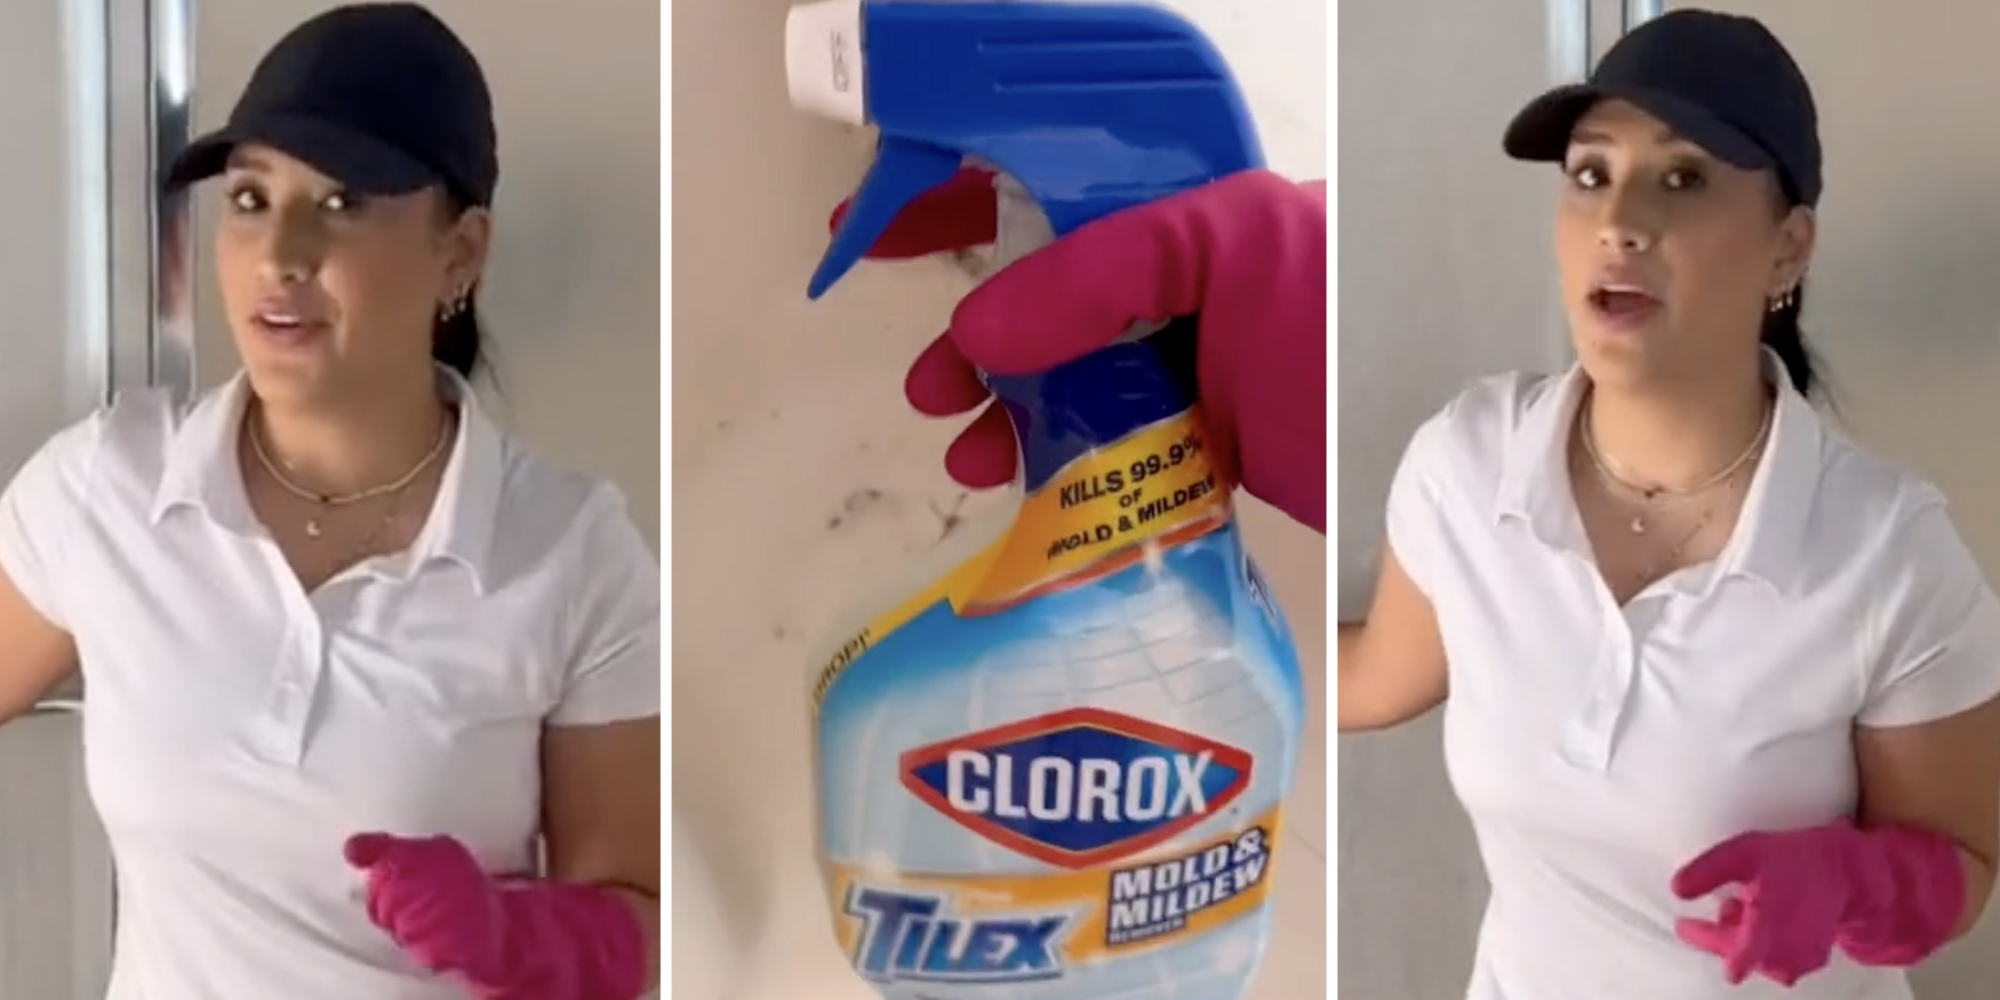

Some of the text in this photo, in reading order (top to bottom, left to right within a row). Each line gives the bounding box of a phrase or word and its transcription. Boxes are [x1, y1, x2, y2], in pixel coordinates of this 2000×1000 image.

[1060, 432, 1203, 510] KILLS 99.9%
[1118, 487, 1143, 509] OF
[1046, 524, 1113, 561] MOLD
[1117, 515, 1134, 533] &
[946, 749, 1215, 822] CLOROX
[1109, 852, 1266, 931] MILDEW
[1111, 827, 1268, 902] MOLD &
[848, 882, 1076, 980] TILEX
